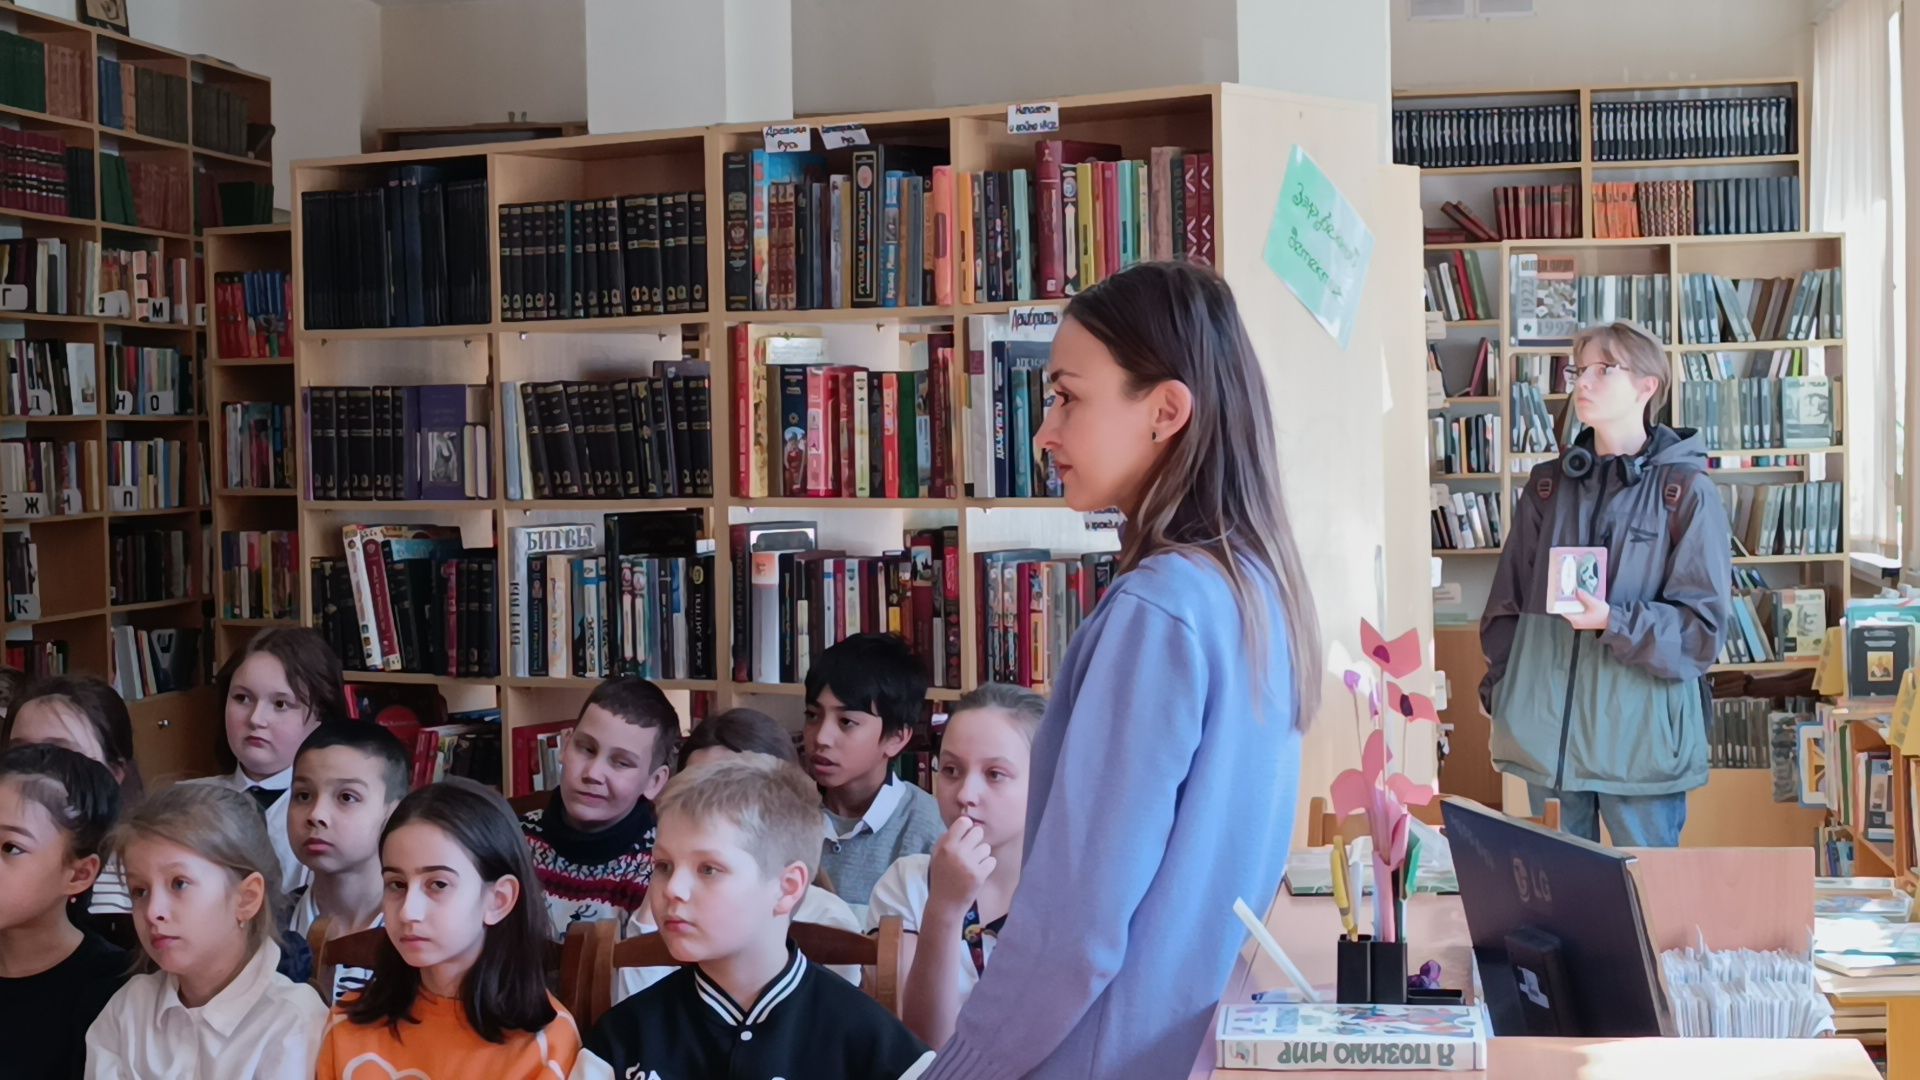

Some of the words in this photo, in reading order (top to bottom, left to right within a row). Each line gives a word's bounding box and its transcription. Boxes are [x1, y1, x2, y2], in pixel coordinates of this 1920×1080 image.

[2, 288, 12, 306] Г
[1521, 280, 1534, 313] 1922
[152, 302, 164, 318] М
[1537, 320, 1575, 336] 1997
[116, 394, 125, 410] Н
[24, 497, 40, 514] Ж
[123, 491, 133, 507] П
[526, 526, 595, 551] БИТВЫ
[16, 599, 28, 614] К
[510, 581, 521, 646] БИТВЫ
[1531, 867, 1552, 902] LG
[1277, 1042, 1328, 1065] МИР
[1333, 1042, 1431, 1065] ПОЗНАЮ
[1437, 1043, 1455, 1066] Я
